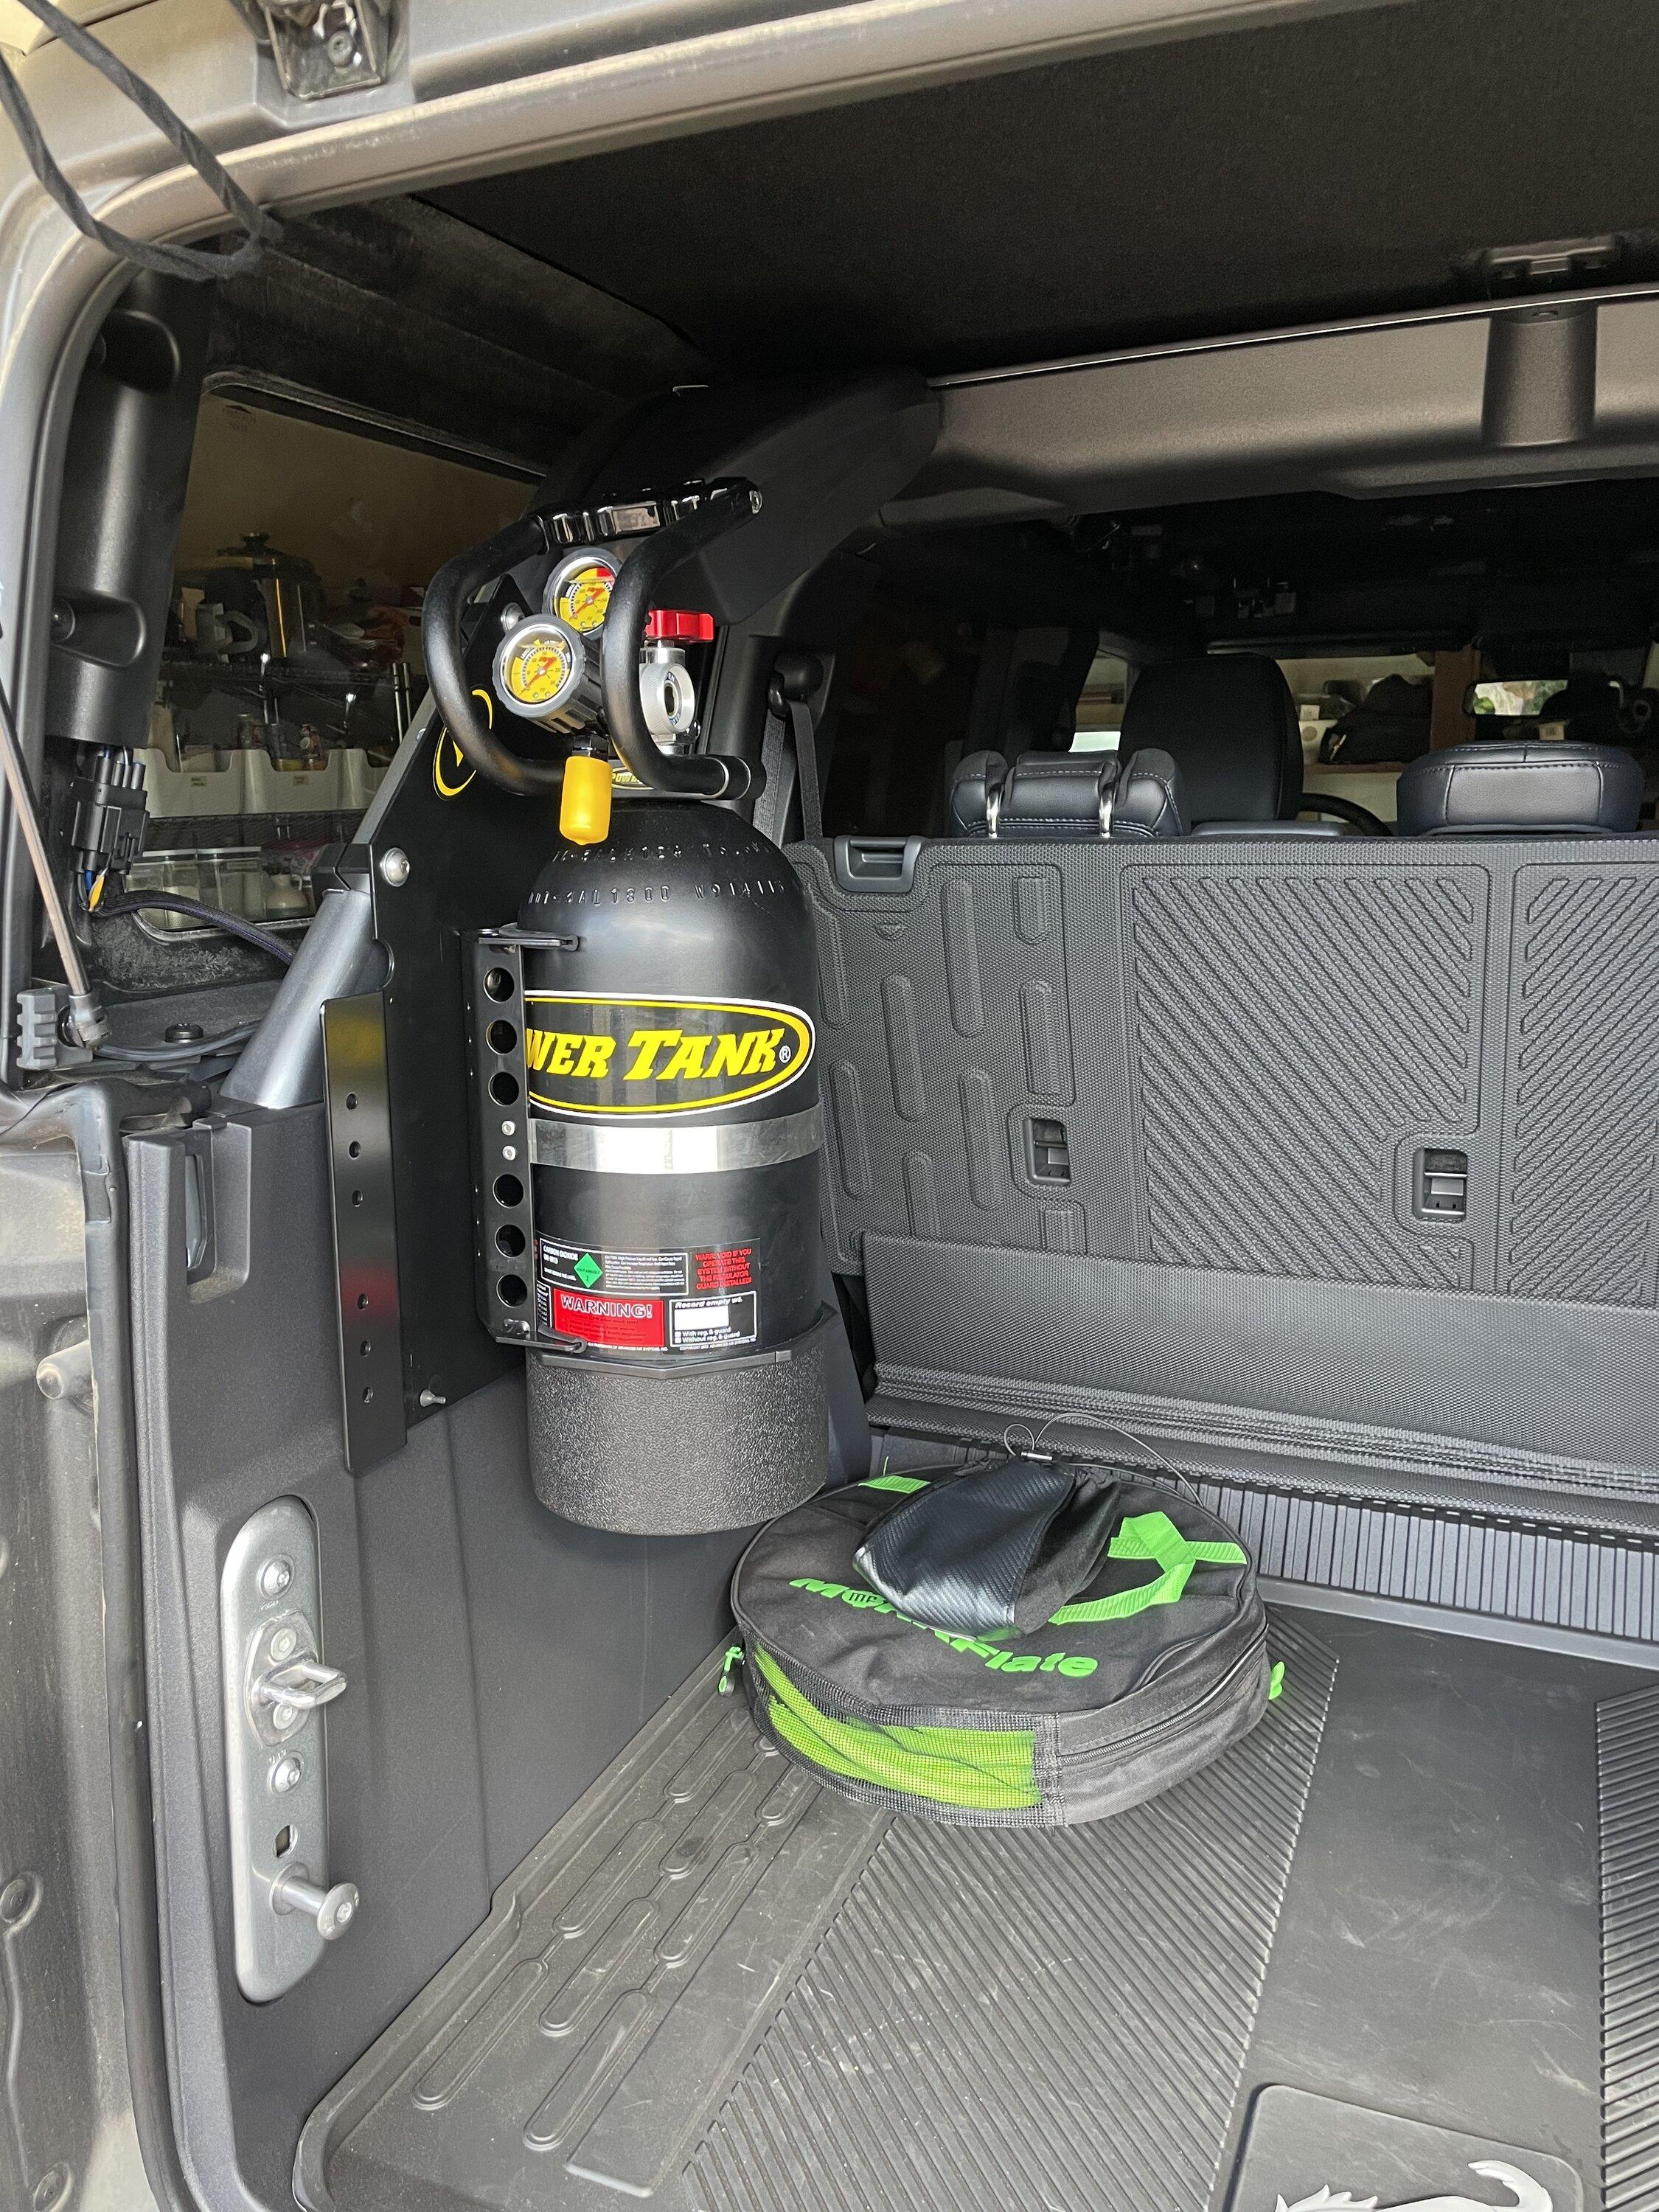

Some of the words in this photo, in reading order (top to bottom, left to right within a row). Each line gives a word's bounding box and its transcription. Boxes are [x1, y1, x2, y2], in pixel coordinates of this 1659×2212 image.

[622, 1028, 785, 1081] TANK
[696, 1281, 719, 1290] GUARD
[560, 1294, 653, 1318] WARNING!
[675, 1300, 706, 1309] Record
[706, 1298, 731, 1307] empty
[714, 1326, 731, 1335] guard
[682, 1335, 706, 1343] Without
[723, 1331, 741, 1340] guard
